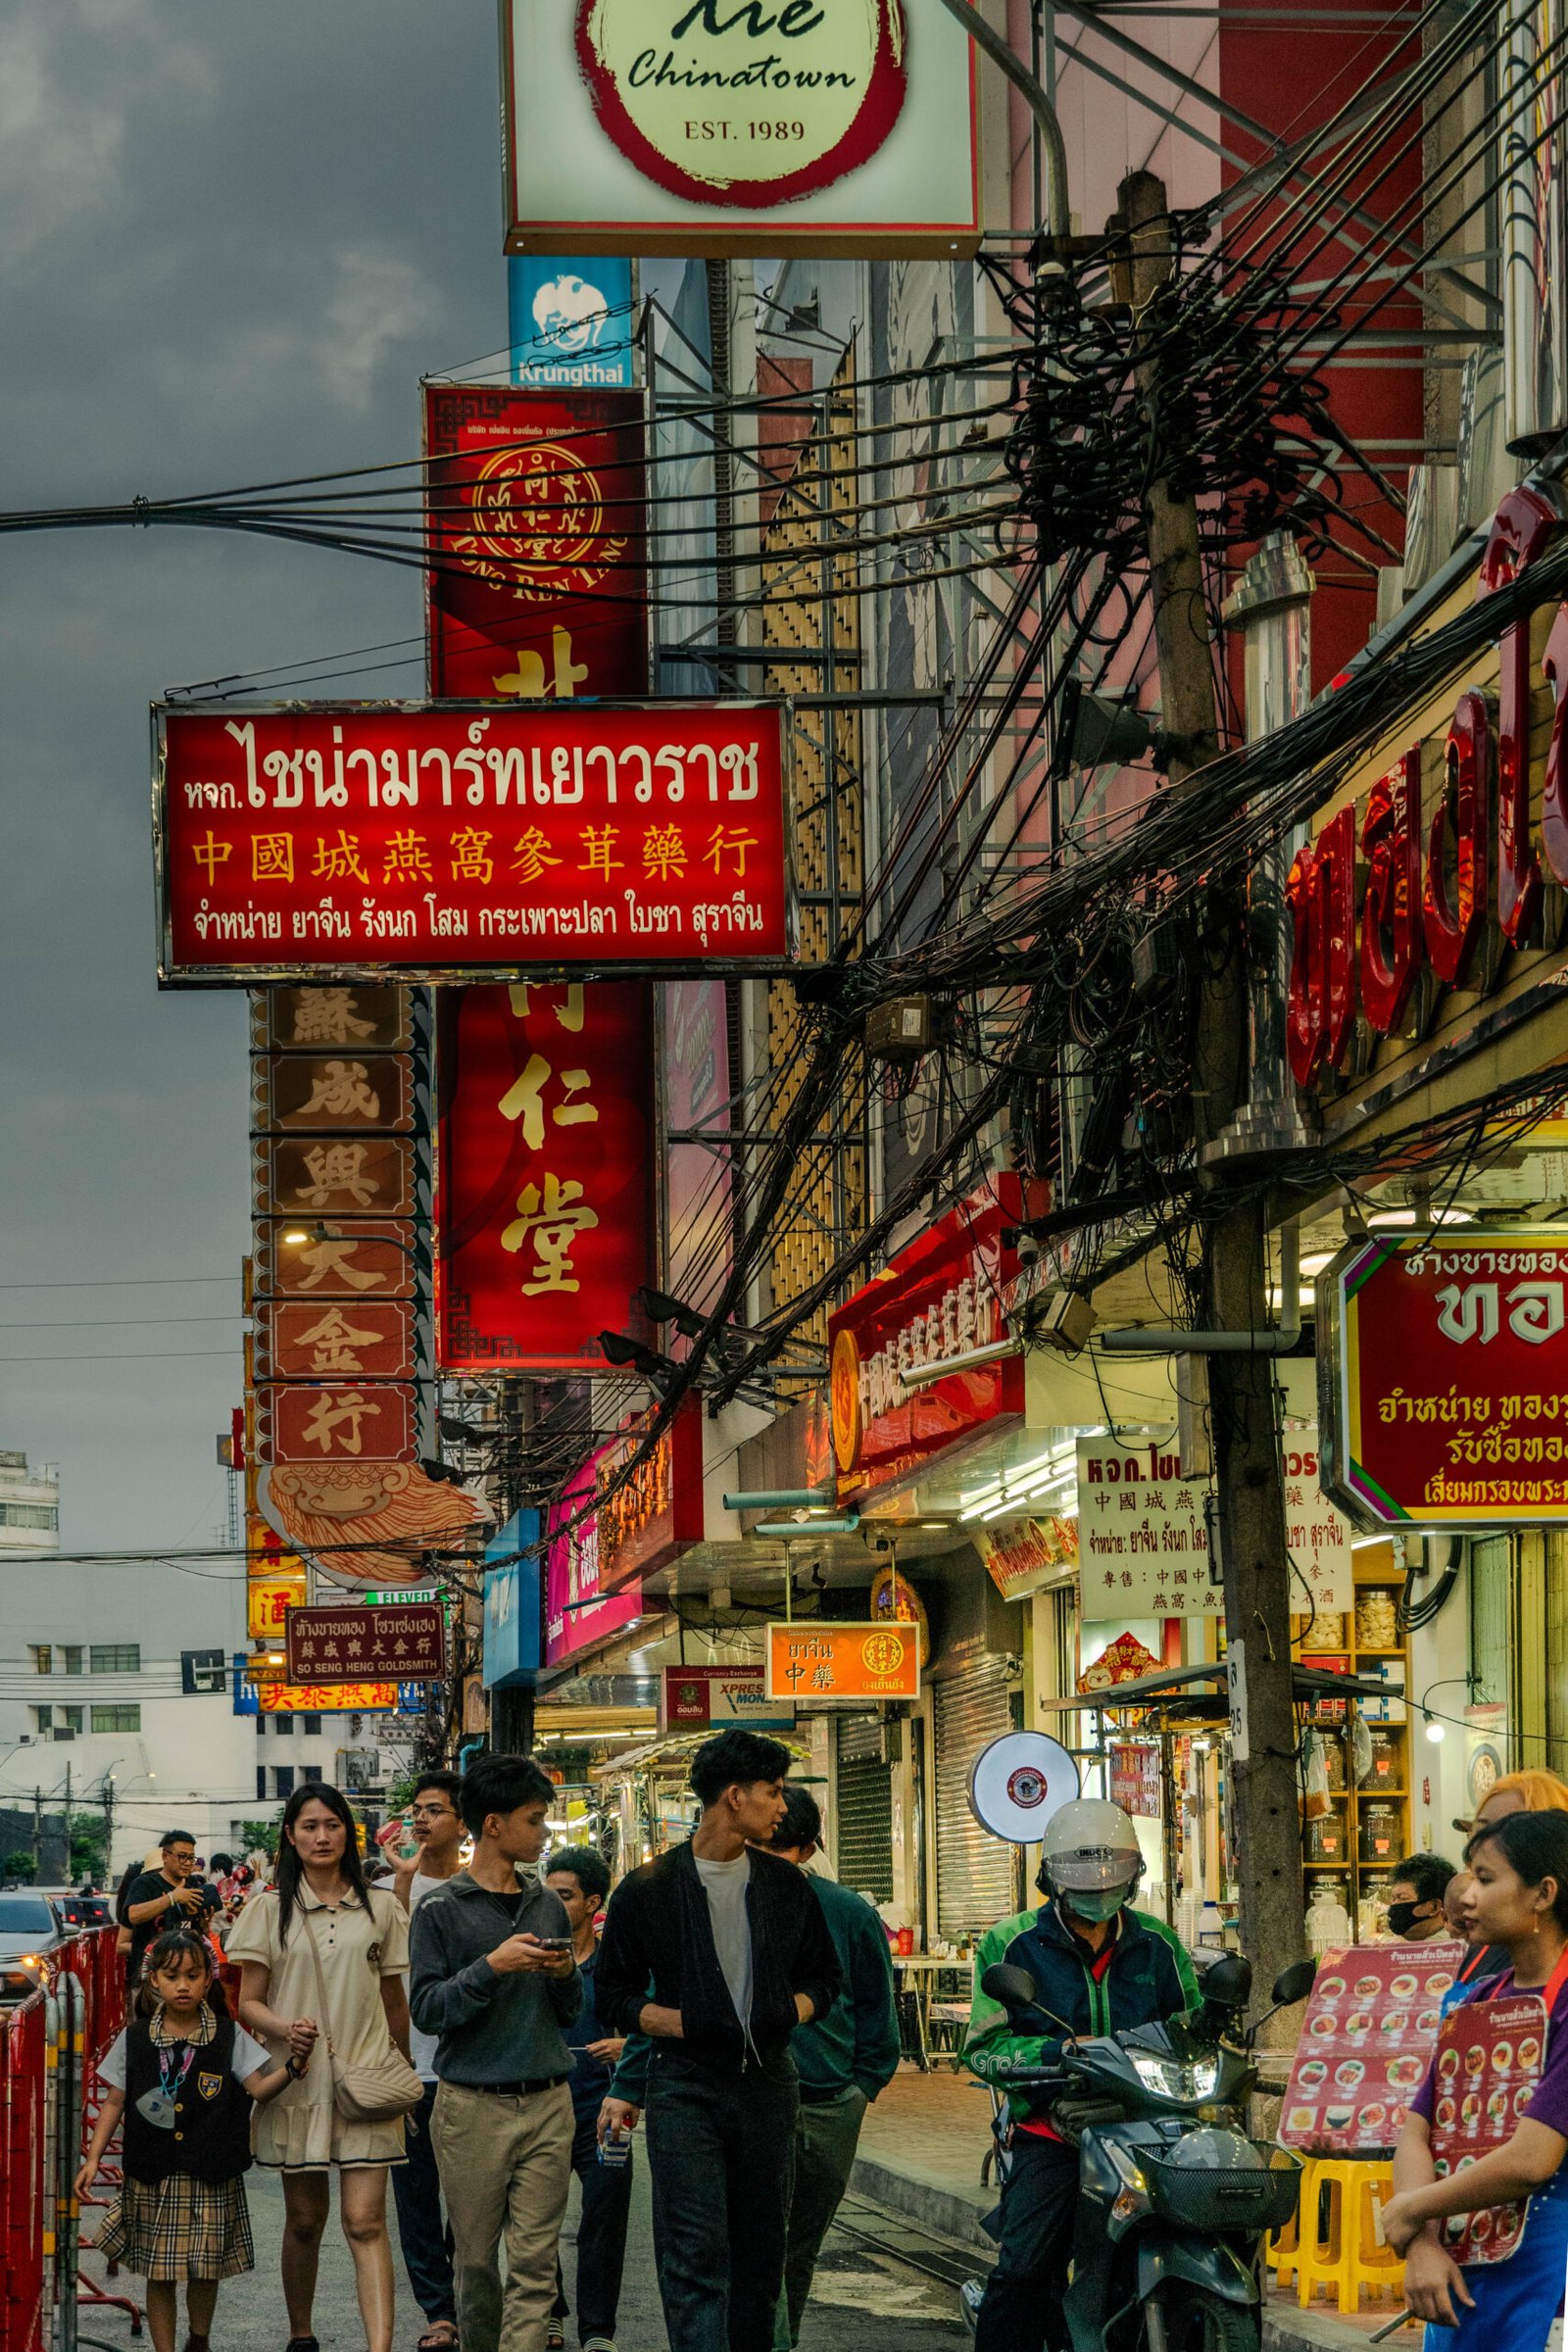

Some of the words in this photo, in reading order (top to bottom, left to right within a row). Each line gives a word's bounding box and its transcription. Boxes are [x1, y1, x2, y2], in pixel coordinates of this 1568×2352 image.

[628, 49, 856, 88] Chinatown
[684, 121, 737, 140] EST.
[747, 121, 805, 140] 1989
[519, 362, 623, 387] Krungthai
[450, 529, 507, 591] TONG
[512, 573, 571, 602] REN
[571, 530, 628, 589] TANG
[191, 822, 760, 888] 中國城燕窩參茸藥行
[194, 898, 282, 940] จำหน่าย
[293, 896, 351, 939] ยาจีน
[360, 897, 417, 938] รังนก
[423, 892, 468, 937] โสม
[478, 899, 617, 936] กระเพาะปลา
[623, 888, 682, 933] ใบชา
[691, 889, 763, 948] สุราจีน
[1378, 1384, 1491, 1423] จำหน่าย
[1424, 1466, 1568, 1503] เลี่ยมกรอบพระ
[1130, 1518, 1158, 1553] ยาจีน
[1161, 1520, 1188, 1552] รังนก
[1310, 1511, 1344, 1562] สุราจีน
[296, 1618, 367, 1638] ห้างขายทอง
[789, 1638, 833, 1659] ยาจีน
[296, 1664, 312, 1675] SO
[315, 1663, 343, 1674] SENG
[346, 1661, 374, 1673] HENG
[377, 1659, 437, 1672] GOLDSMITH
[785, 1662, 836, 1692] 中藥
[720, 1684, 764, 1694] XPRES
